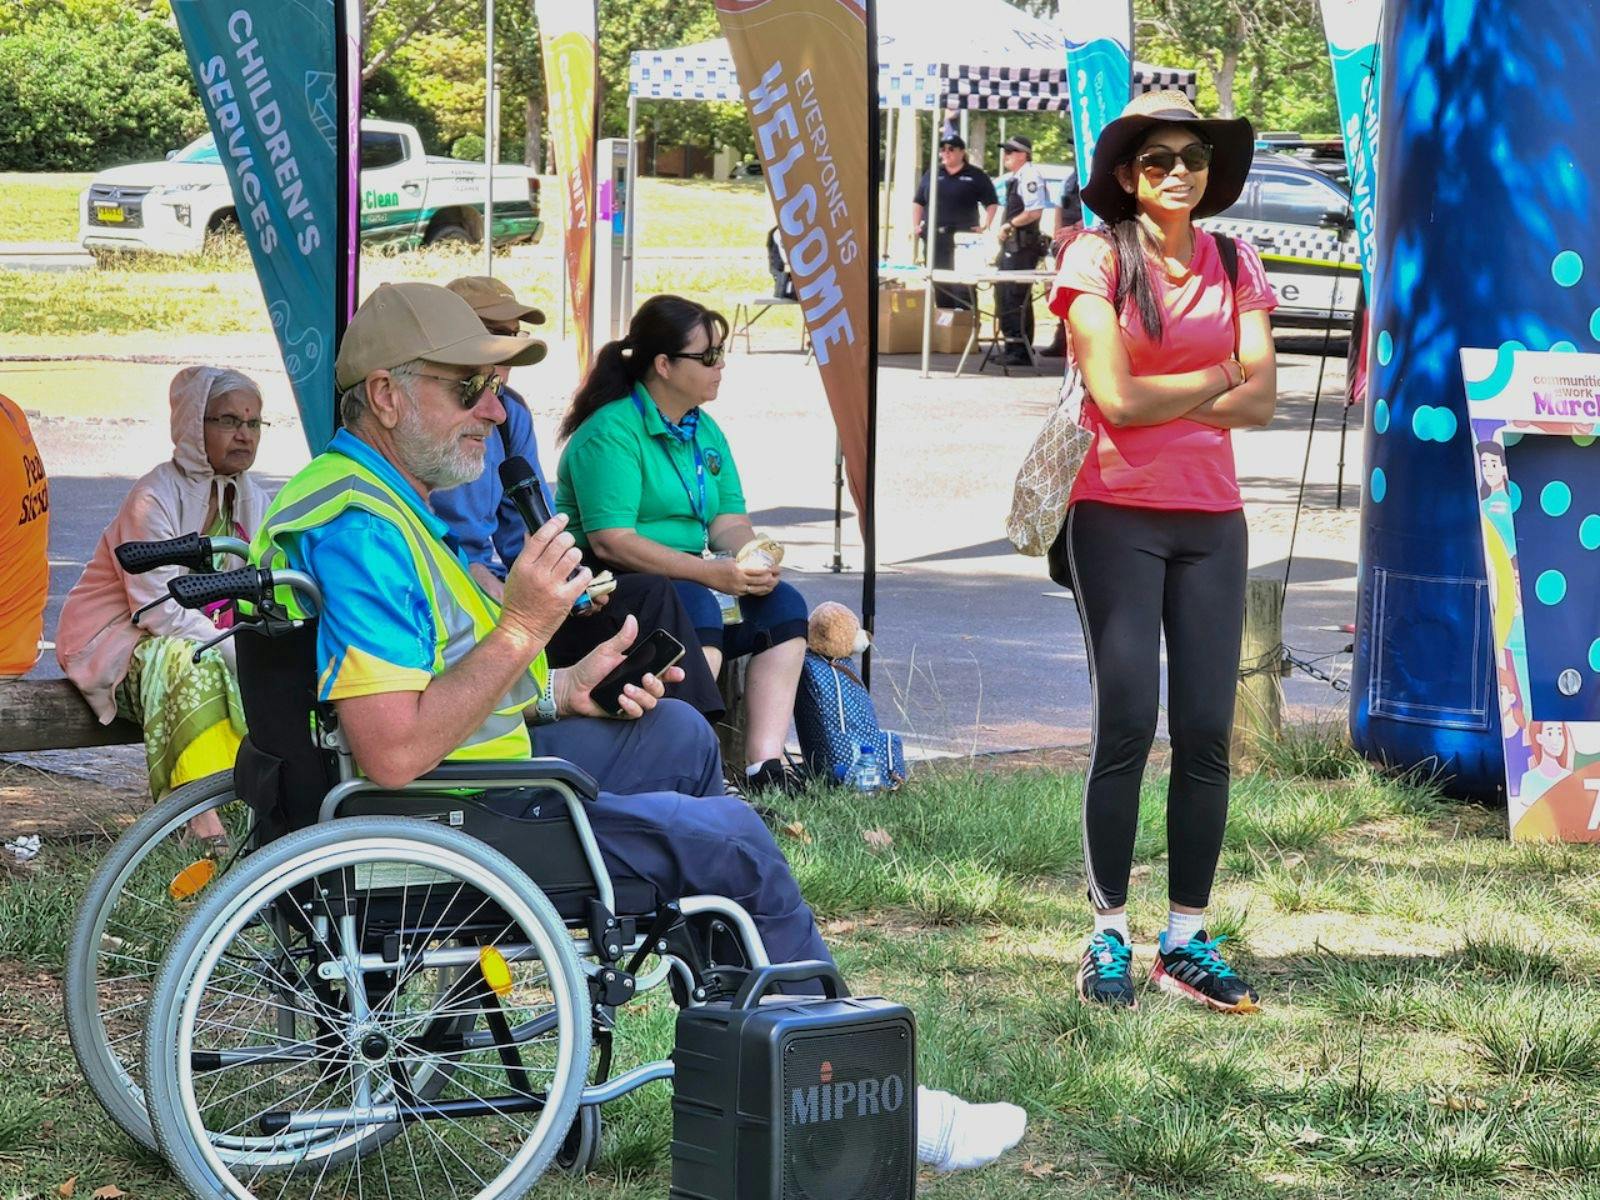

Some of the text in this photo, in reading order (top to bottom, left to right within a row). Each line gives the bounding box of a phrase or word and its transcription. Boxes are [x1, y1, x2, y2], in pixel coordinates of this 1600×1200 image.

[200, 55, 278, 254] SERVICES
[228, 9, 320, 256] CHILDREN'S
[749, 60, 855, 366] WELCOME
[795, 68, 858, 265] EVERYONE IS
